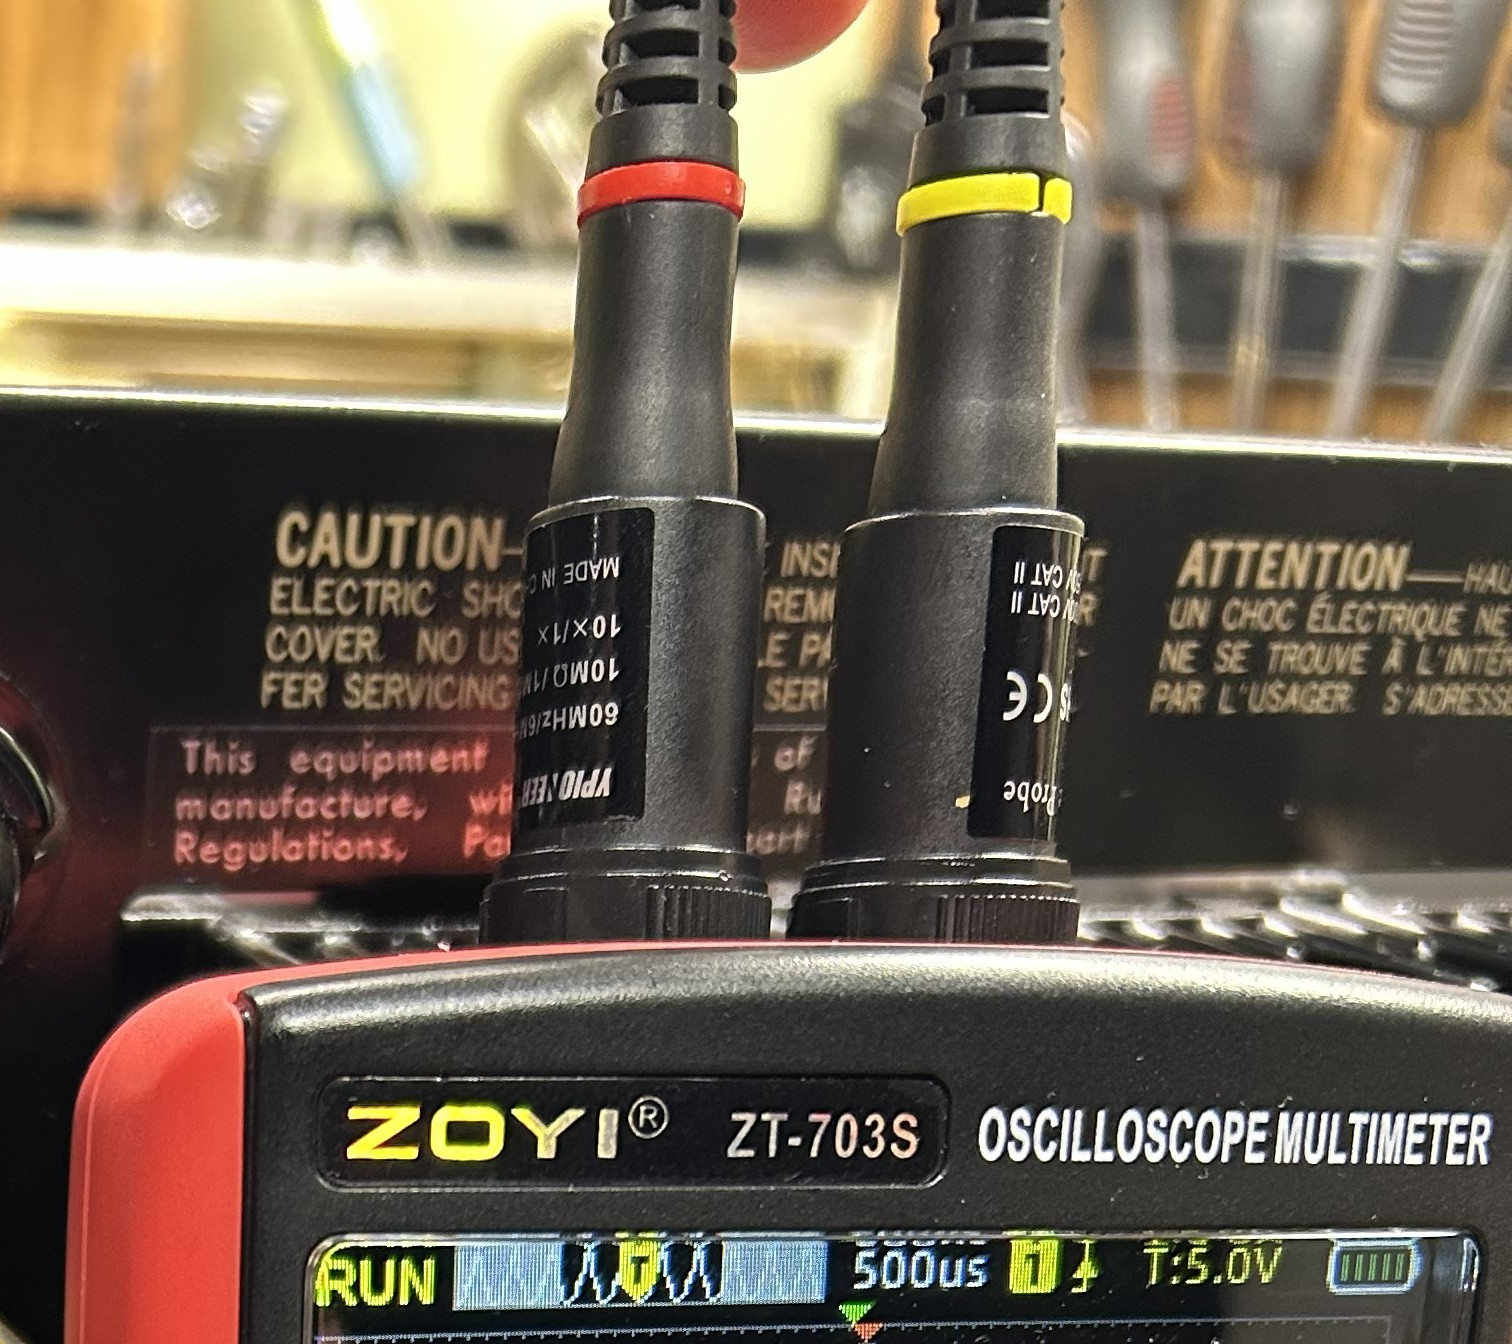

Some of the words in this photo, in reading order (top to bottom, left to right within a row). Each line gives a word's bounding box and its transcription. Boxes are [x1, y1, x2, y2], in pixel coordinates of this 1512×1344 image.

[541, 567, 556, 590] IN
[564, 556, 621, 585] MADE
[1030, 563, 1063, 588] CAT
[270, 576, 436, 618] ELECTRIC
[1028, 592, 1061, 618] CAT
[1169, 599, 1211, 631] UN
[1222, 599, 1299, 632] CHOC
[415, 627, 467, 665] NO
[1159, 640, 1201, 674] NE
[1214, 640, 1253, 674] SE
[1267, 641, 1372, 675] TROUVE
[260, 671, 329, 709] FER
[343, 671, 513, 710] SERVICING
[1149, 681, 1207, 714] PAR
[182, 738, 257, 775] This
[290, 739, 488, 782] equipment
[726, 1111, 921, 1160] ZT-703S
[977, 1106, 1268, 1165] OSCILLOSCOPE
[1273, 1111, 1493, 1168] MULTIMETER
[314, 1254, 436, 1308] RUN
[852, 1244, 989, 1291] 500us
[1143, 1240, 1283, 1288] T:5.0V
